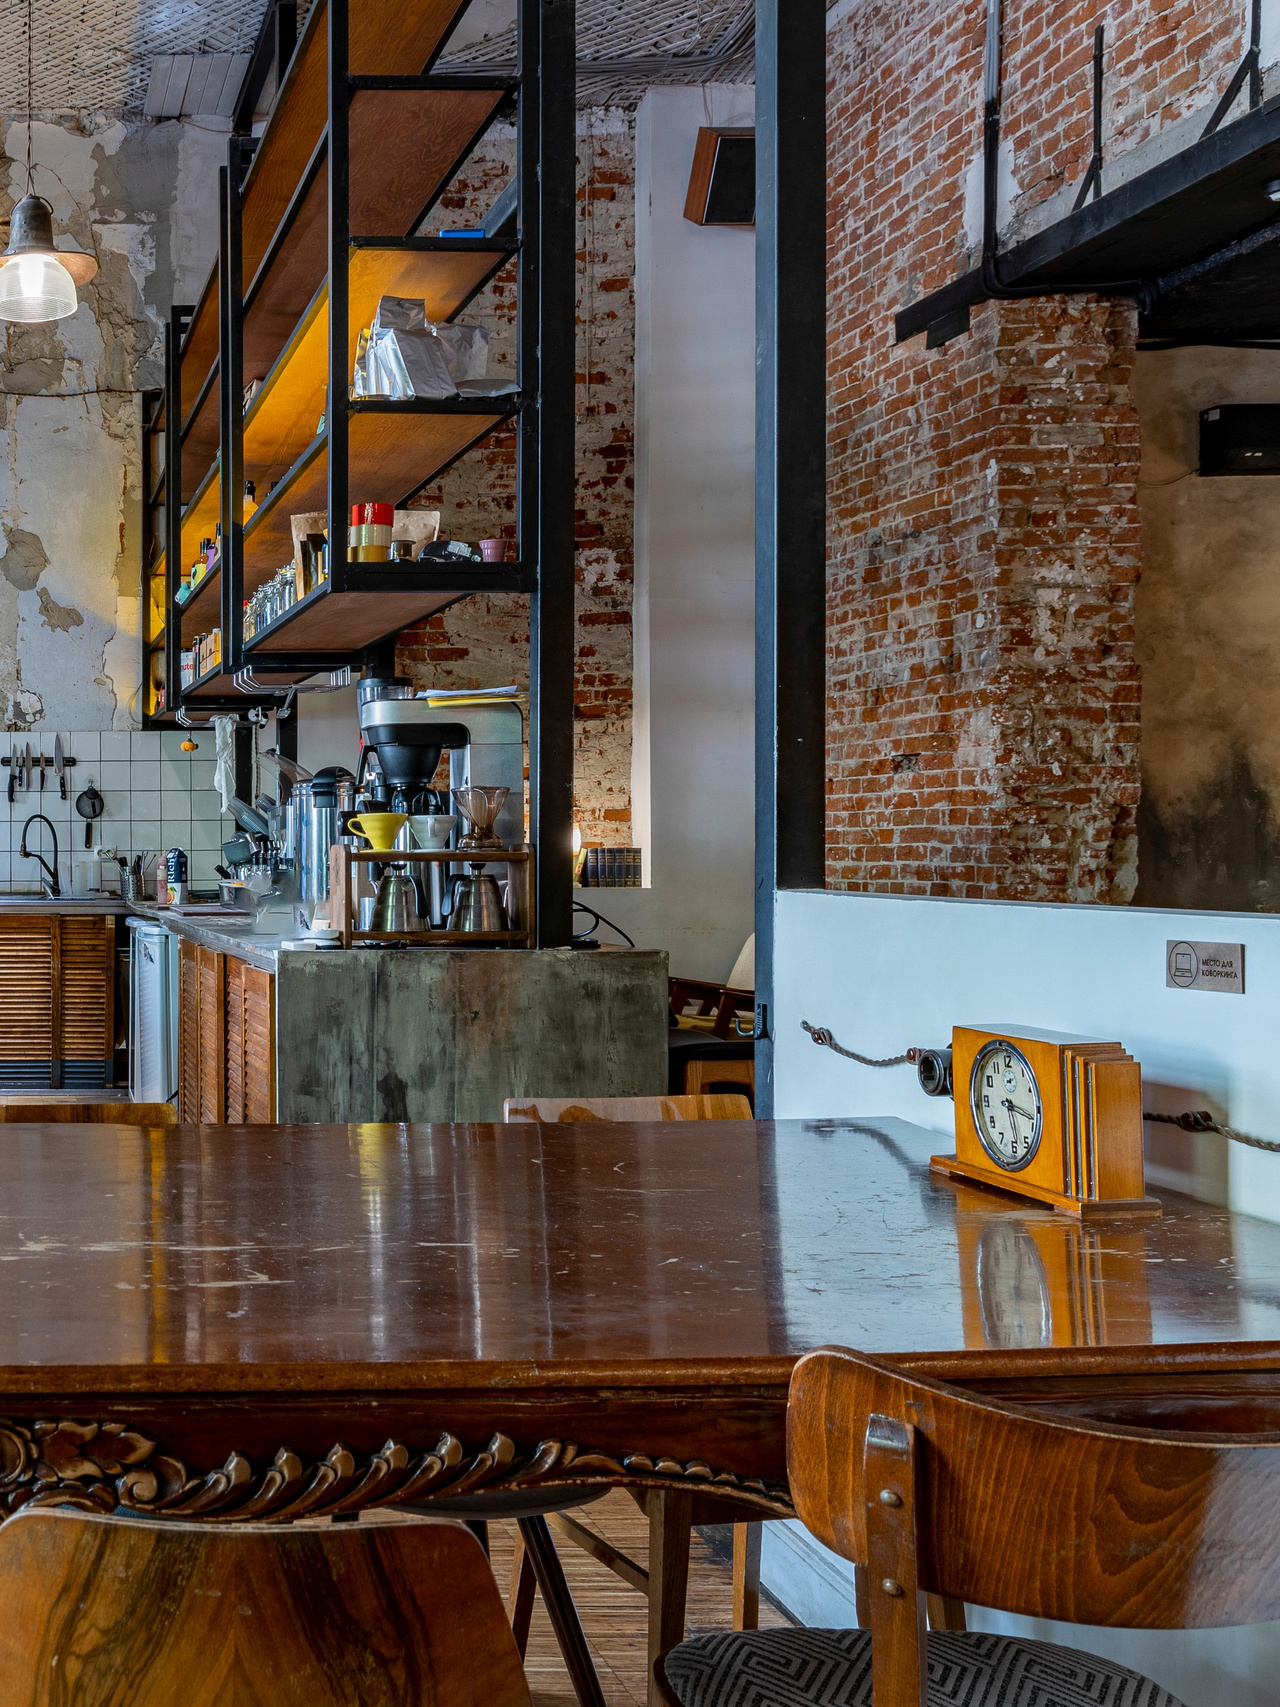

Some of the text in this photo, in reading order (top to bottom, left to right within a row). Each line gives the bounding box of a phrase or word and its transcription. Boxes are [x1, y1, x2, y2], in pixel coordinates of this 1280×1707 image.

[167, 858, 175, 882] Rich
[1202, 959, 1233, 968] МЕСТО ДЛЯ
[1202, 970, 1238, 979] КОВОРКИНГА
[993, 1061, 1000, 1075] 11
[1004, 1055, 1012, 1068] 12
[983, 1095, 990, 1108] 9
[989, 1116, 996, 1128] 8
[998, 1132, 1005, 1145] 7
[1023, 1136, 1030, 1150] 5
[1011, 1140, 1018, 1154] 6
